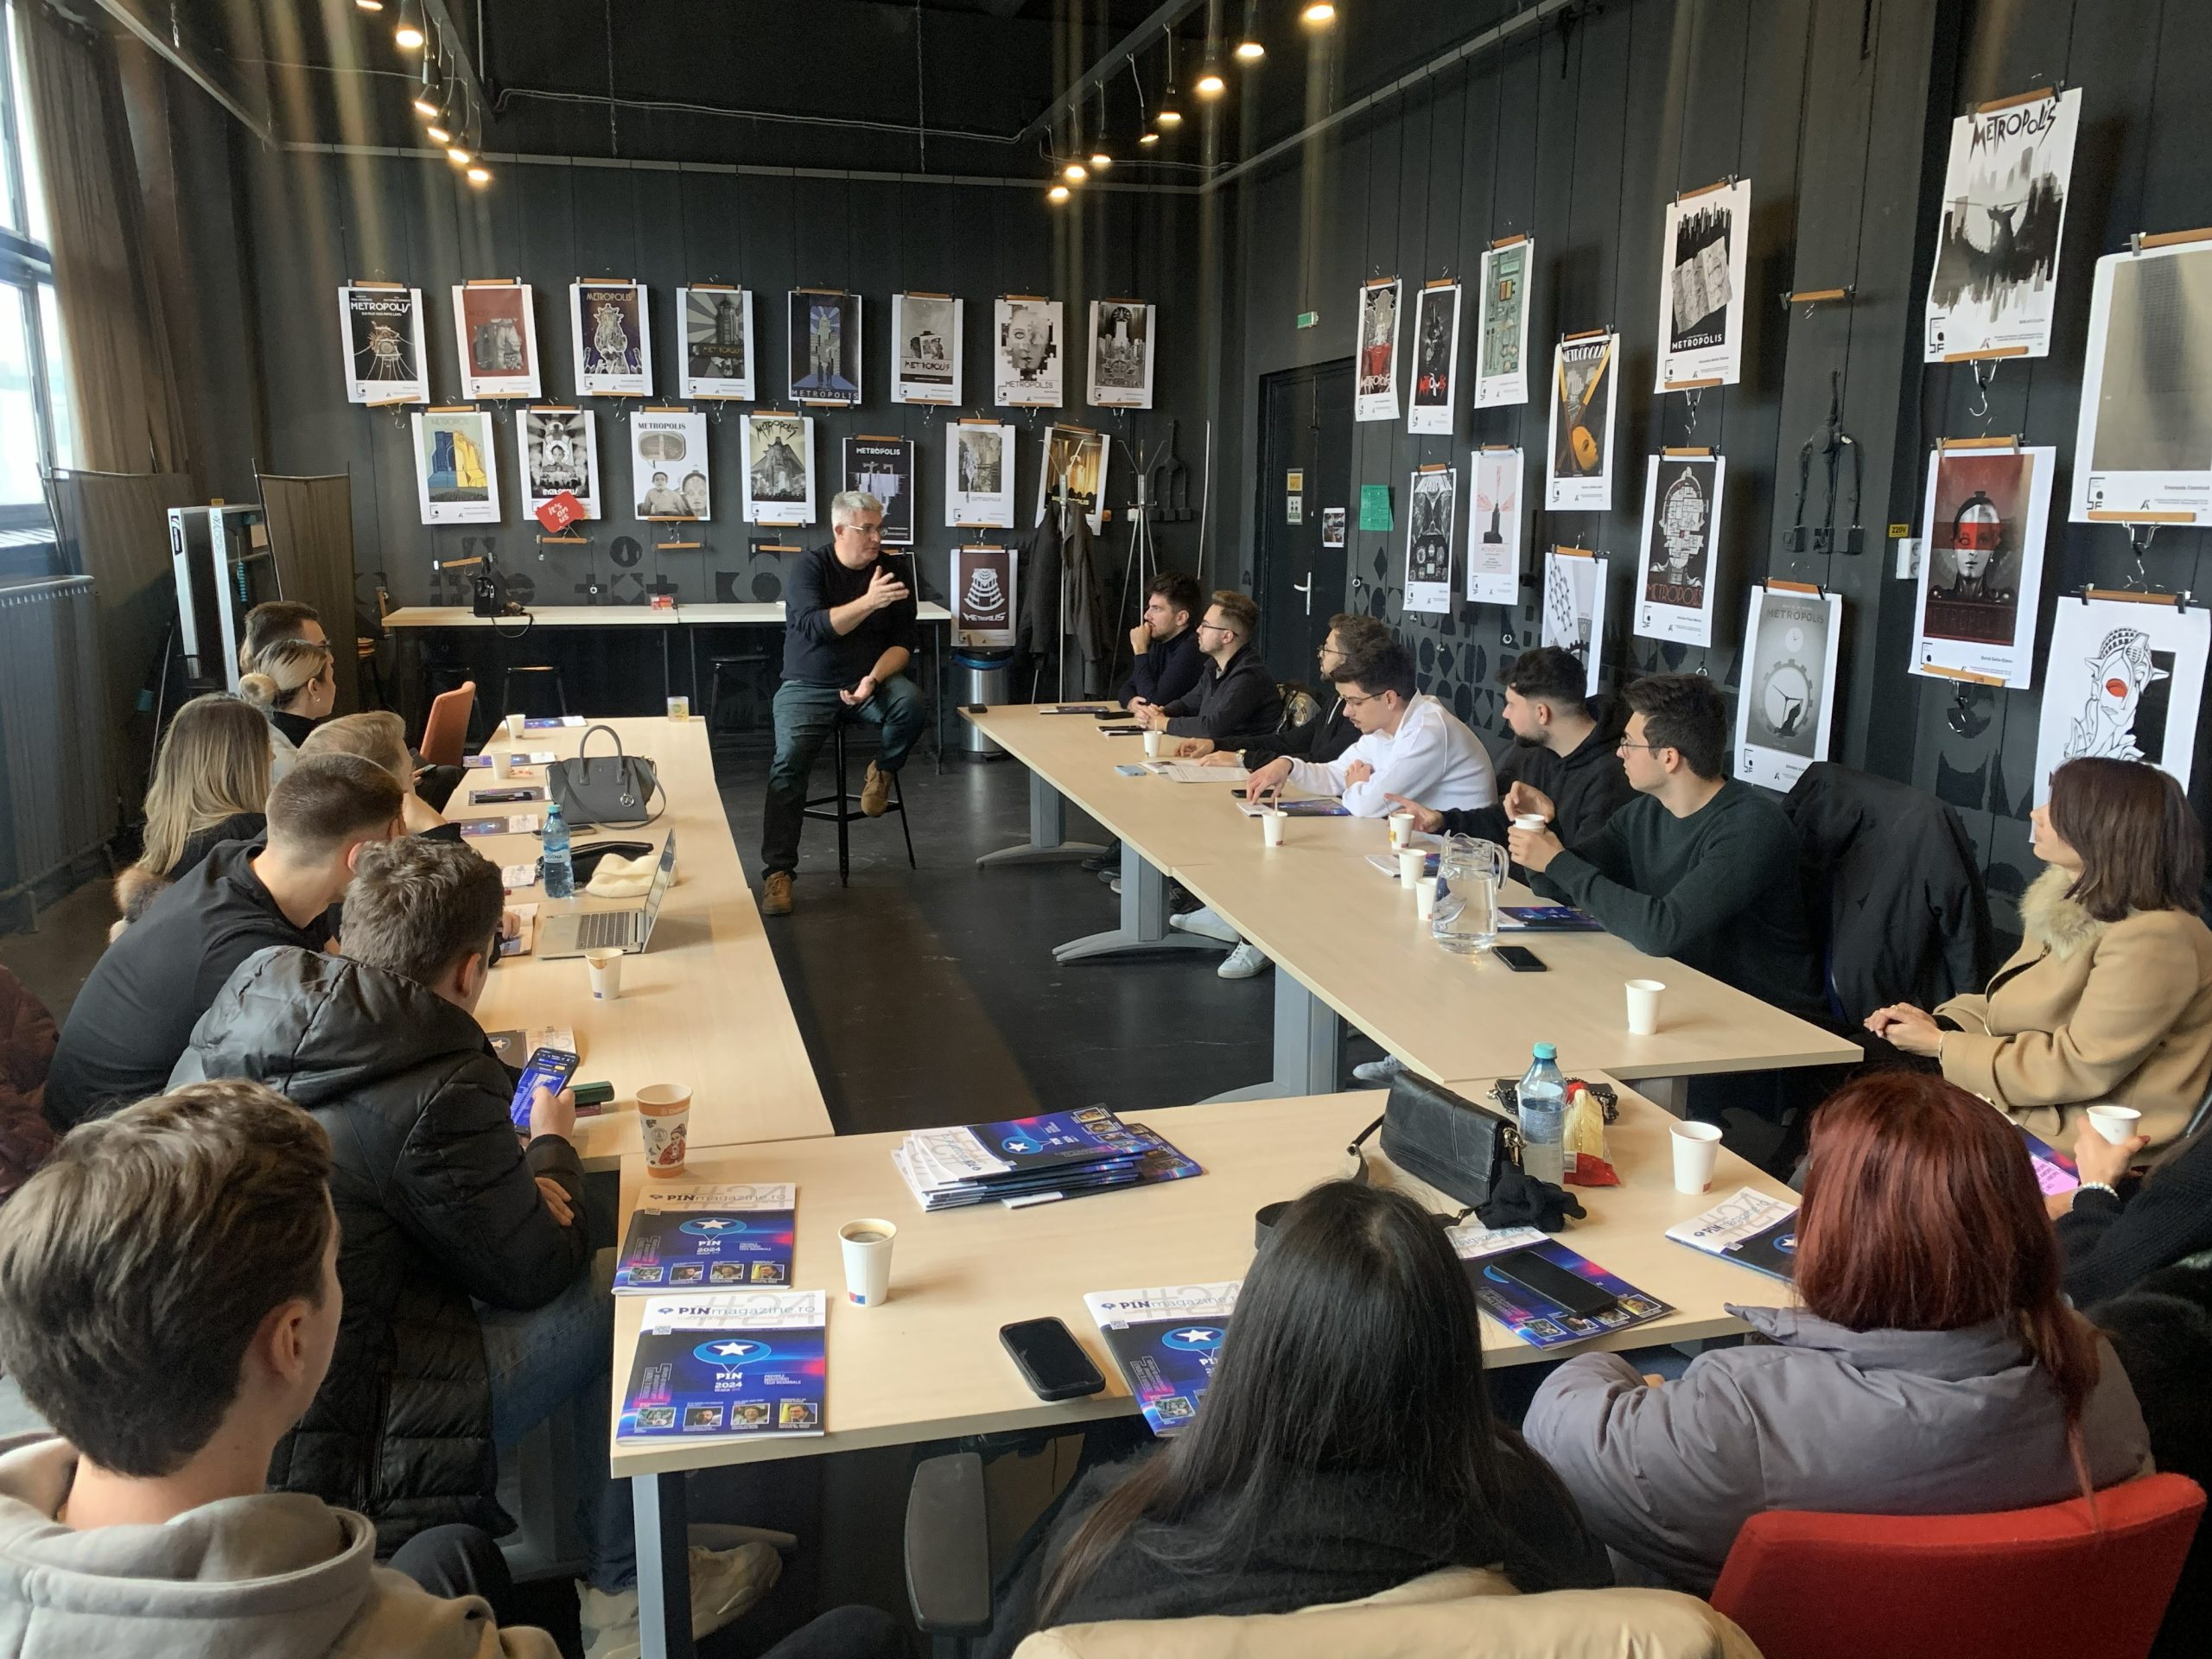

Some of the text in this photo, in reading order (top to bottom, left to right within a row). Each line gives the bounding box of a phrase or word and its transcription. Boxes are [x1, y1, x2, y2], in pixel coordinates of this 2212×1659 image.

[1969, 99, 2056, 161] METROPOLIS
[587, 292, 632, 302] METROPOLIS
[351, 302, 411, 314] METROPOLIS
[1672, 334, 1722, 350] METROPOLIS
[791, 390, 859, 400] METROPOLIS
[756, 420, 798, 442] METROPOLIS
[548, 503, 563, 515] it's
[556, 505, 569, 517] on
[558, 514, 569, 524] us
[1766, 608, 1824, 624] METROPOLIS
[667, 1193, 785, 1203] PINmagazine.ro
[678, 1306, 815, 1315] PINmagazine.ro
